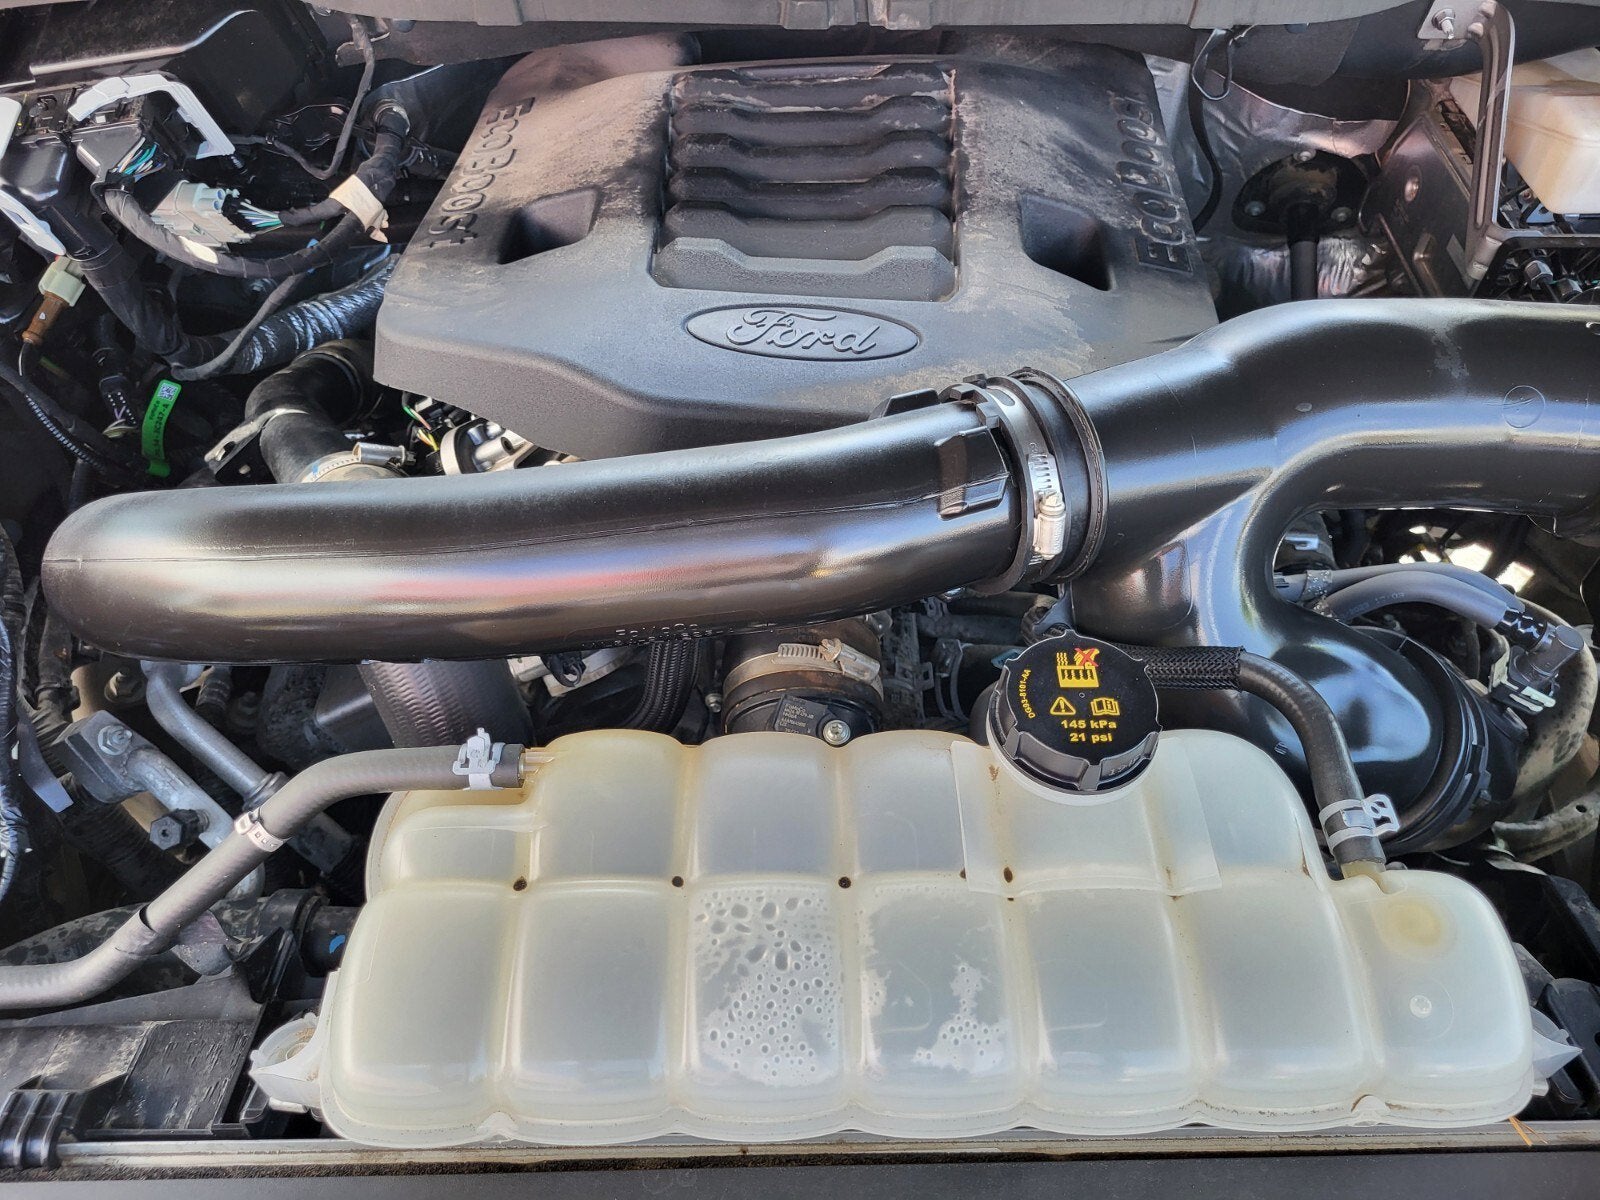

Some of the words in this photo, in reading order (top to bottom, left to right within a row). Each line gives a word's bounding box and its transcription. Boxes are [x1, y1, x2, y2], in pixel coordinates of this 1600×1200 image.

[725, 309, 880, 355] Ford
[1019, 669, 1036, 718] DG93-8101-AA
[1061, 719, 1087, 729] 145
[1090, 719, 1117, 729] kPa
[1069, 732, 1086, 742] 21
[1091, 732, 1113, 744] psi
